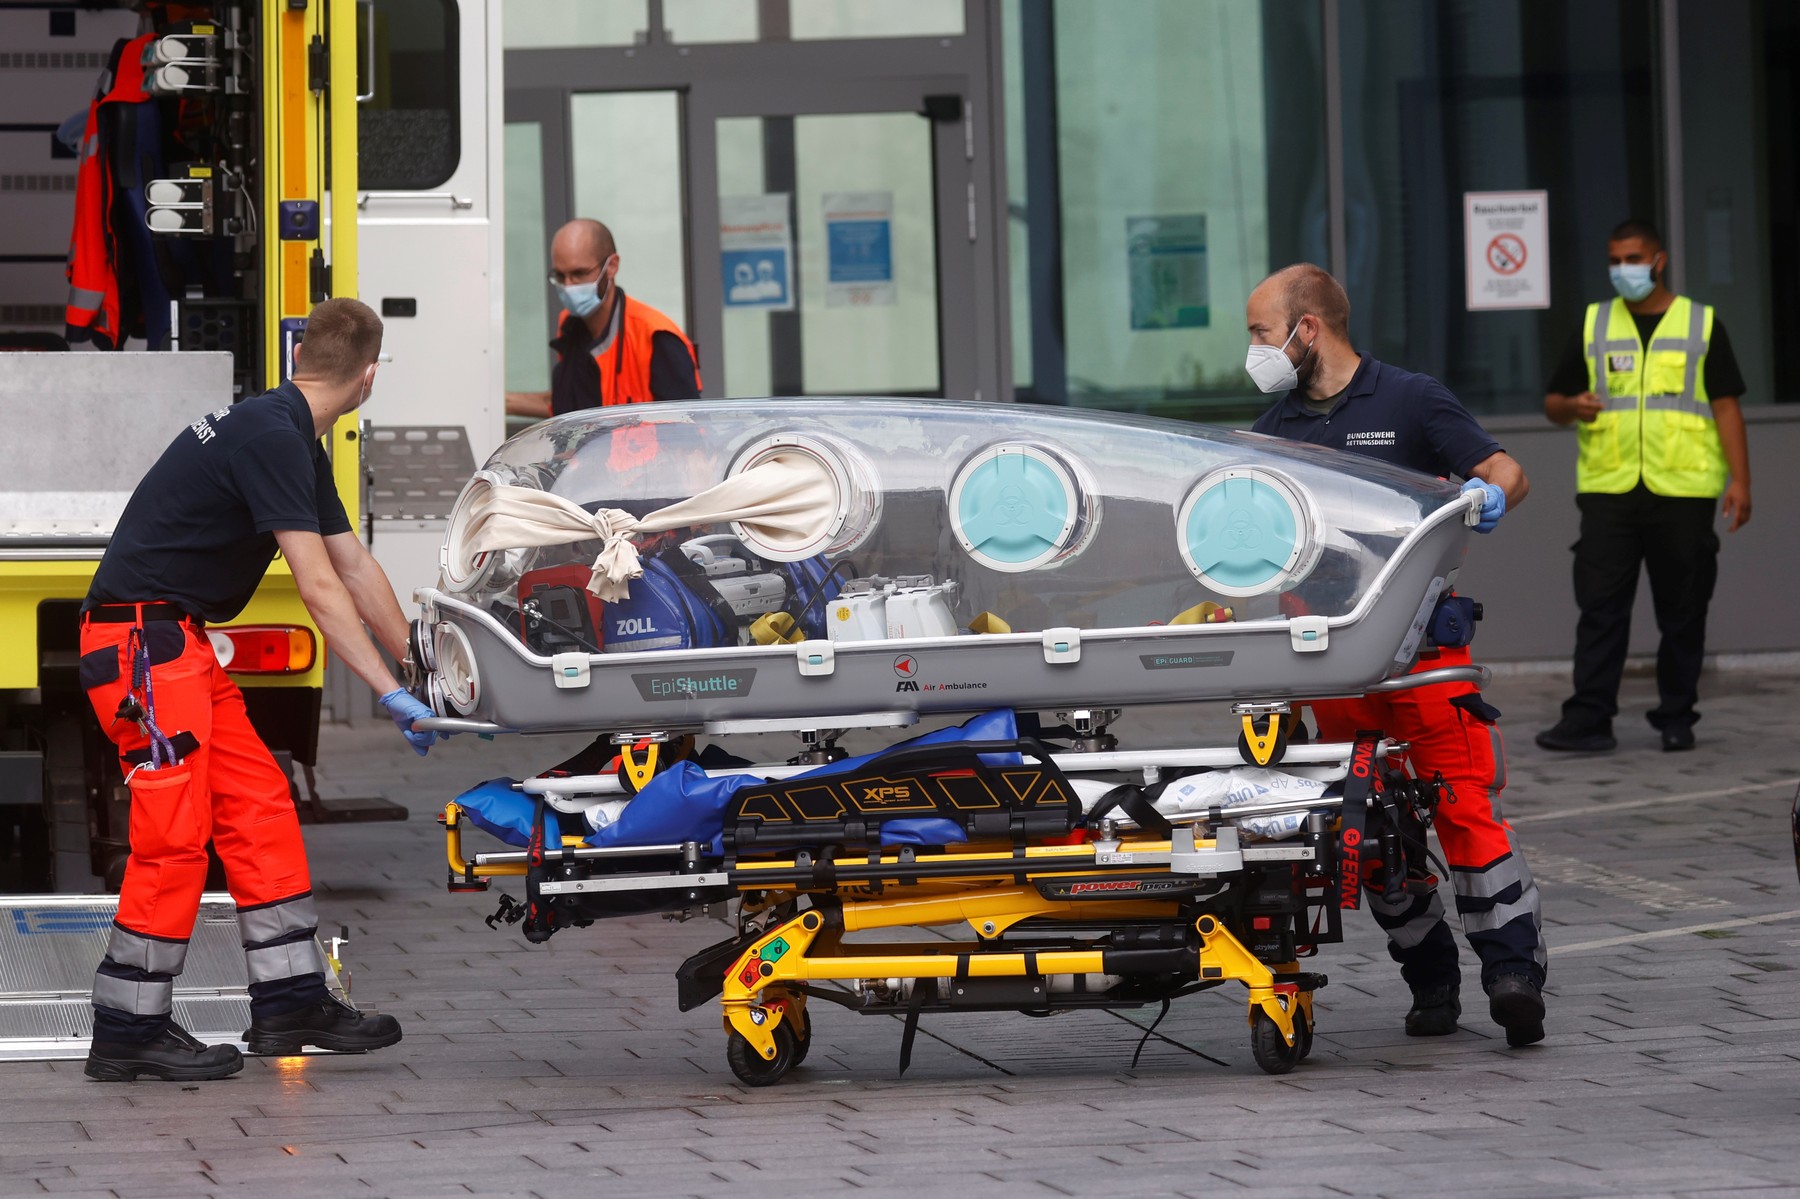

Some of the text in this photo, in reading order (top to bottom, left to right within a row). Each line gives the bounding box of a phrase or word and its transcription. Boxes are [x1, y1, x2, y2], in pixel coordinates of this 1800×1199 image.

[1346, 431, 1396, 440] BUNDESWEHR
[616, 617, 656, 636] ZOLL
[651, 675, 738, 697] EpiShuttle
[923, 684, 936, 692] Air
[938, 682, 988, 691] Ambulance
[863, 786, 910, 804] XPS
[1070, 880, 1141, 894] power
